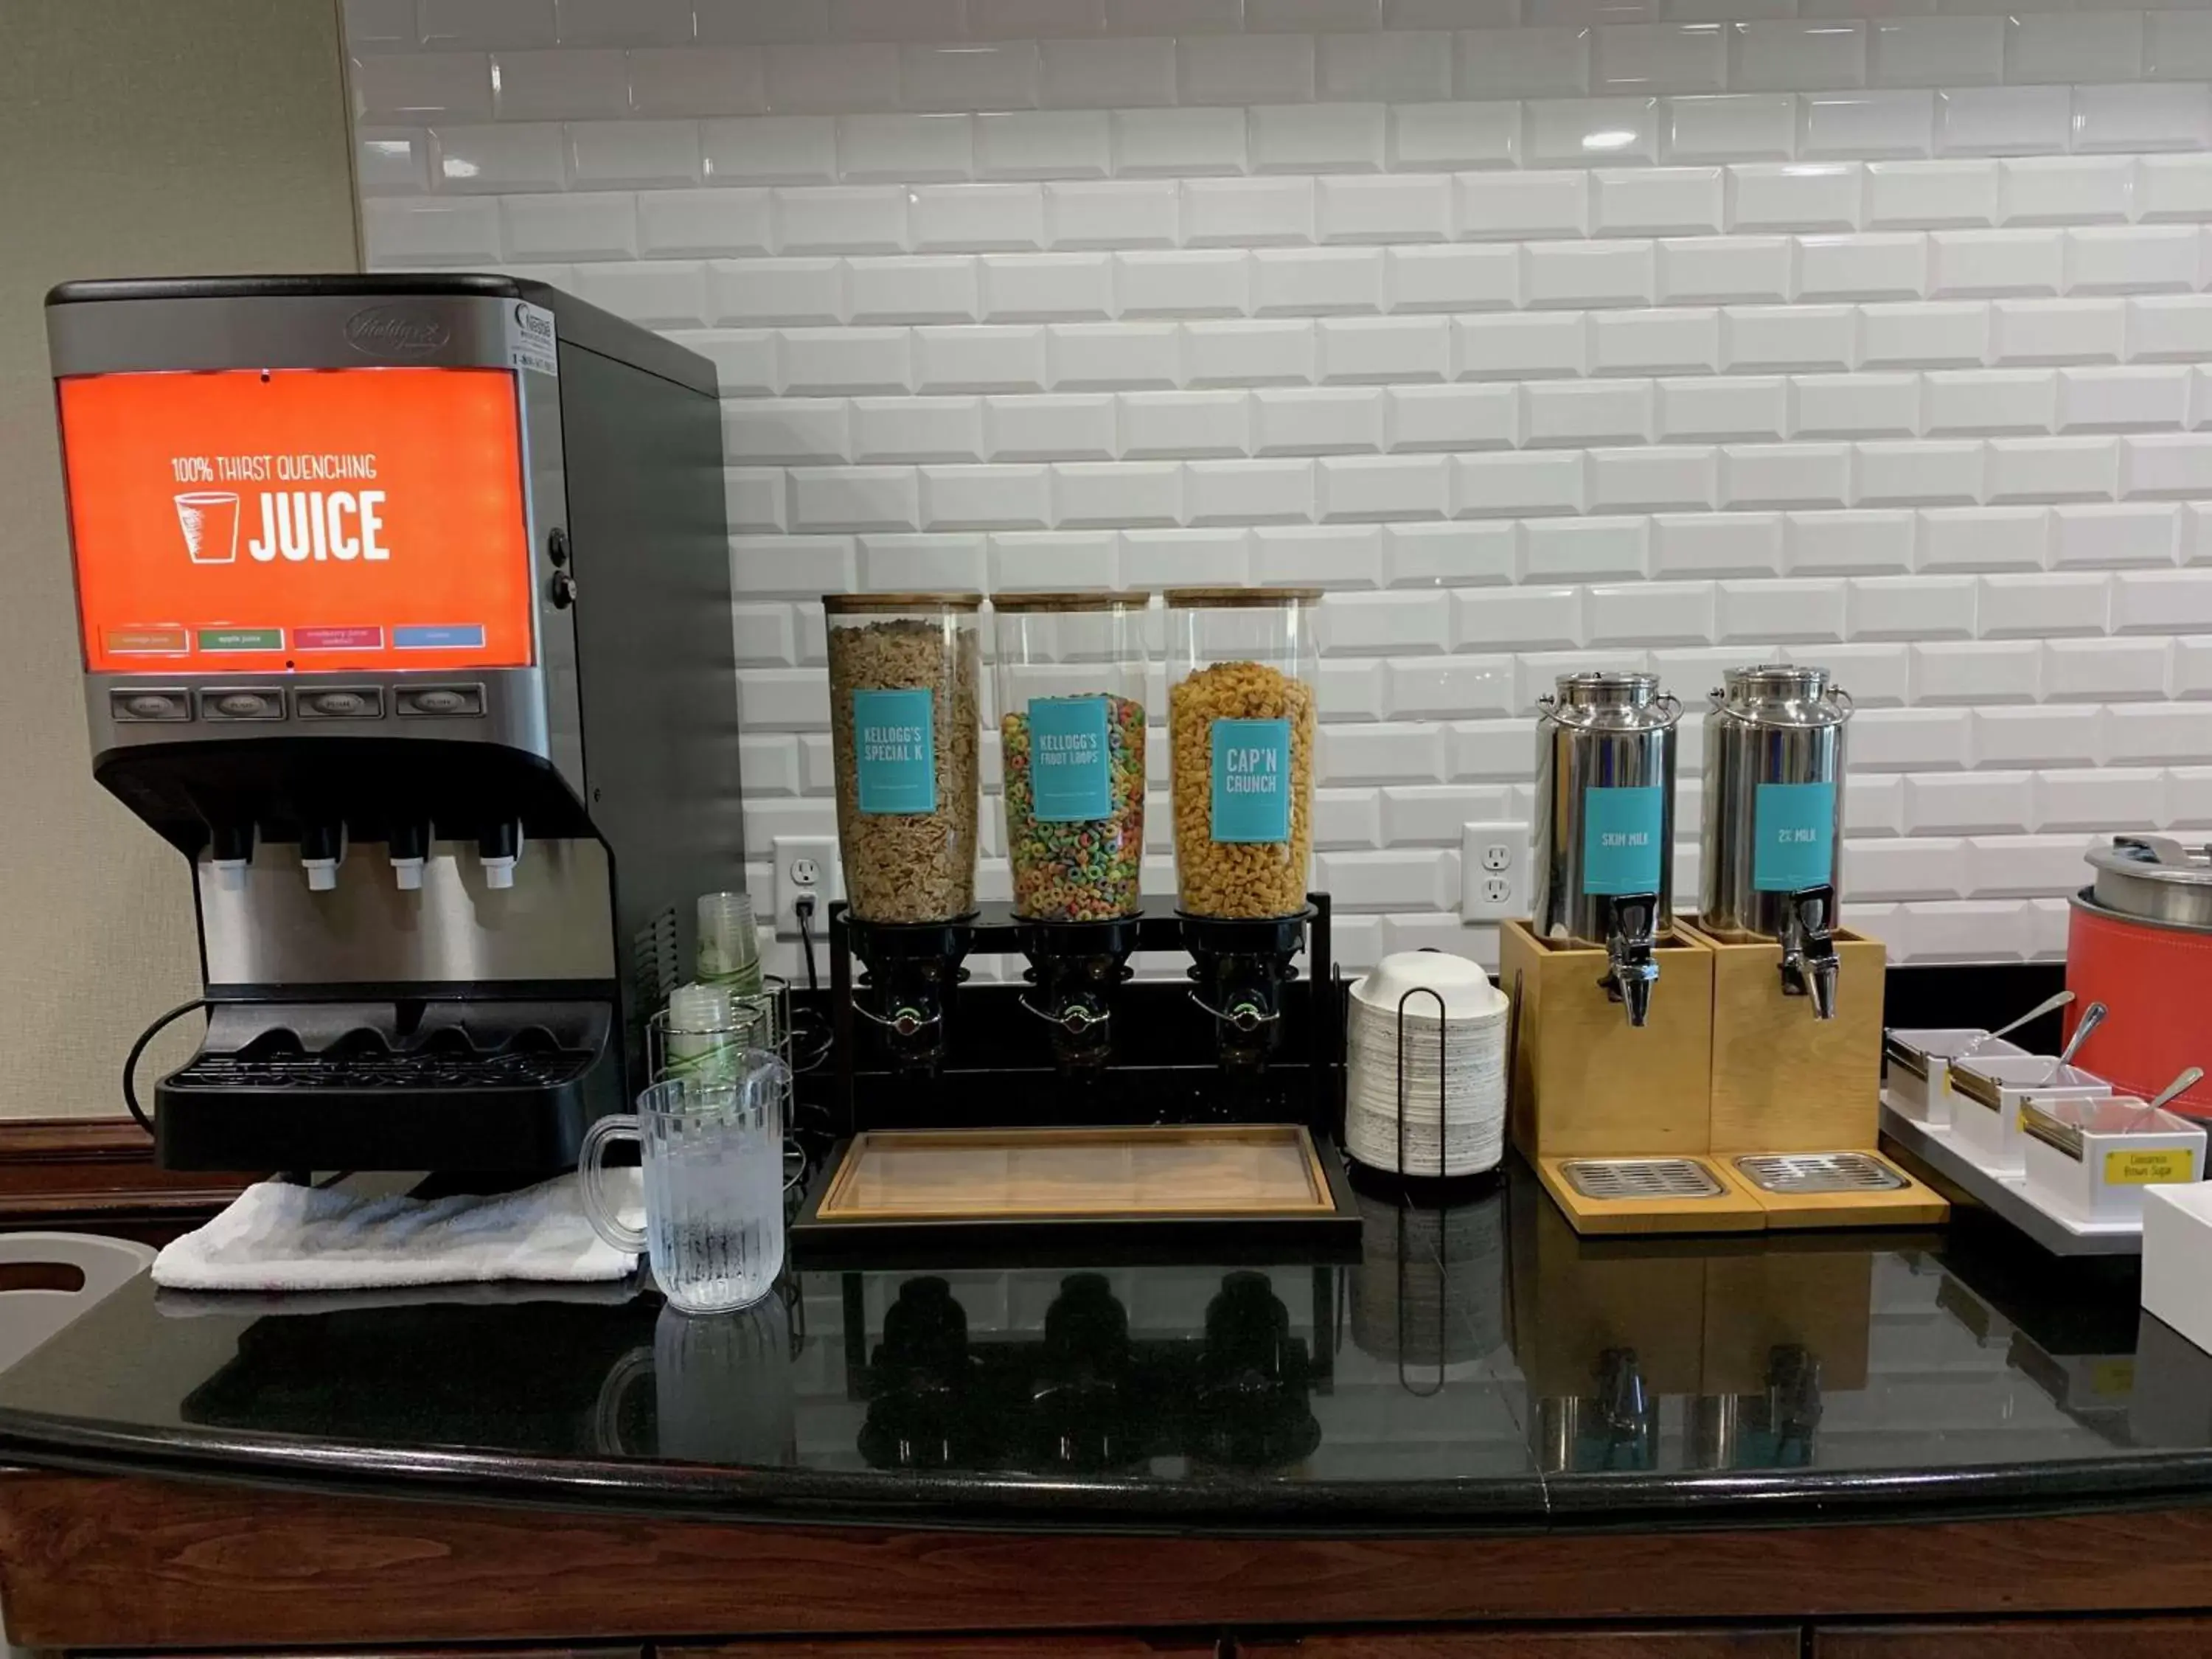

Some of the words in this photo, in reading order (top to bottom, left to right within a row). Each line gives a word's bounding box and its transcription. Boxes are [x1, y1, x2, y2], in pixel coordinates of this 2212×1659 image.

[171, 456, 213, 482] 100%
[216, 454, 273, 482] THIRST
[276, 453, 377, 481] QUENCHING
[248, 490, 390, 561] JUICE
[864, 726, 922, 744] KELLOGG'S
[1039, 733, 1097, 751] KELLOGG'S
[864, 744, 910, 762] SPECIAL
[914, 744, 923, 761] K
[1227, 747, 1277, 773] CAP'N
[1226, 774, 1276, 793] CRUNCH
[1601, 832, 1626, 846] SKIM
[1628, 832, 1649, 846] MILK
[1795, 827, 1817, 842] MILK
